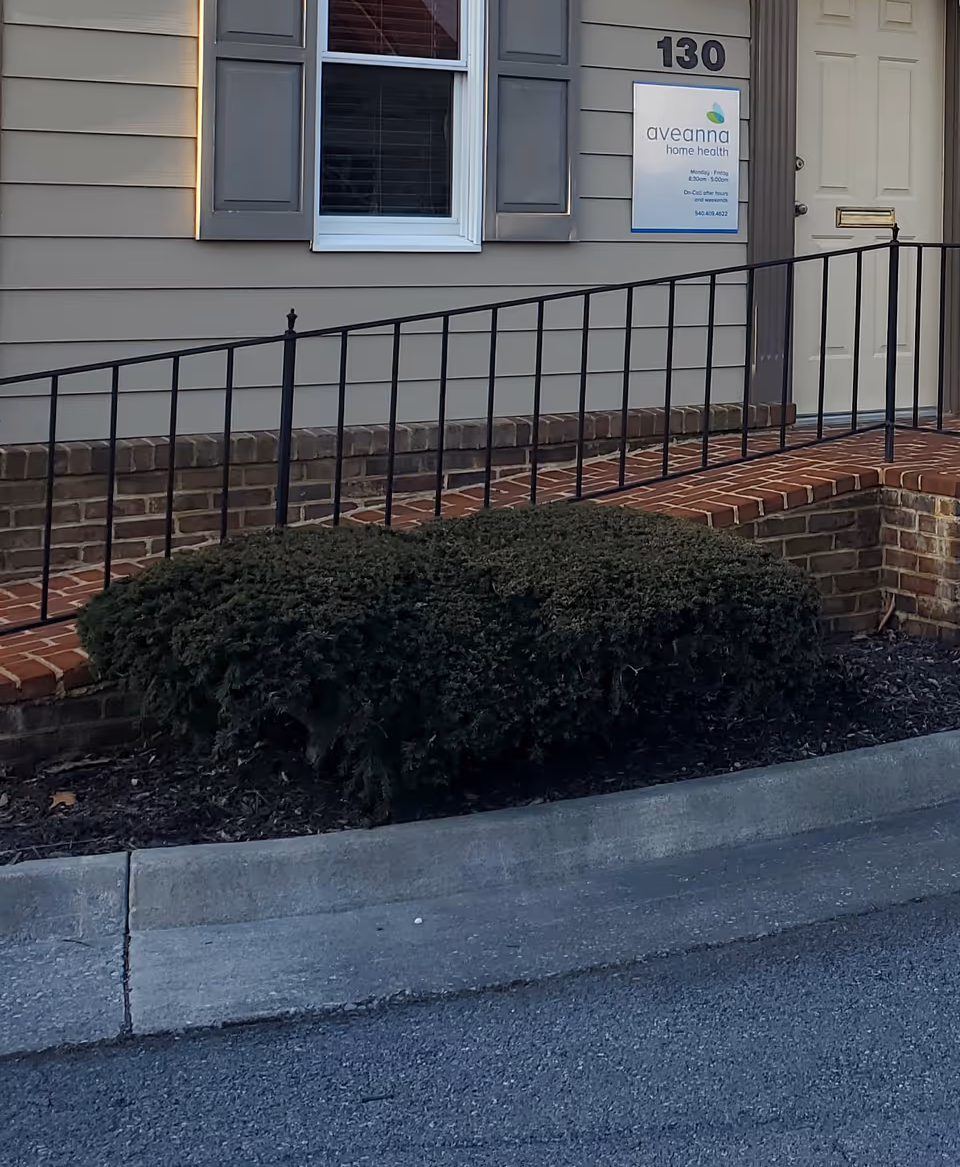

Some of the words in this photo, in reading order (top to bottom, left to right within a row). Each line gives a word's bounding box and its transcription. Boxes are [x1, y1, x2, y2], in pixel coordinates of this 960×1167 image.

[656, 36, 726, 72] 130
[646, 125, 730, 144] aveanna
[666, 144, 695, 156] home
[697, 145, 729, 157] health
